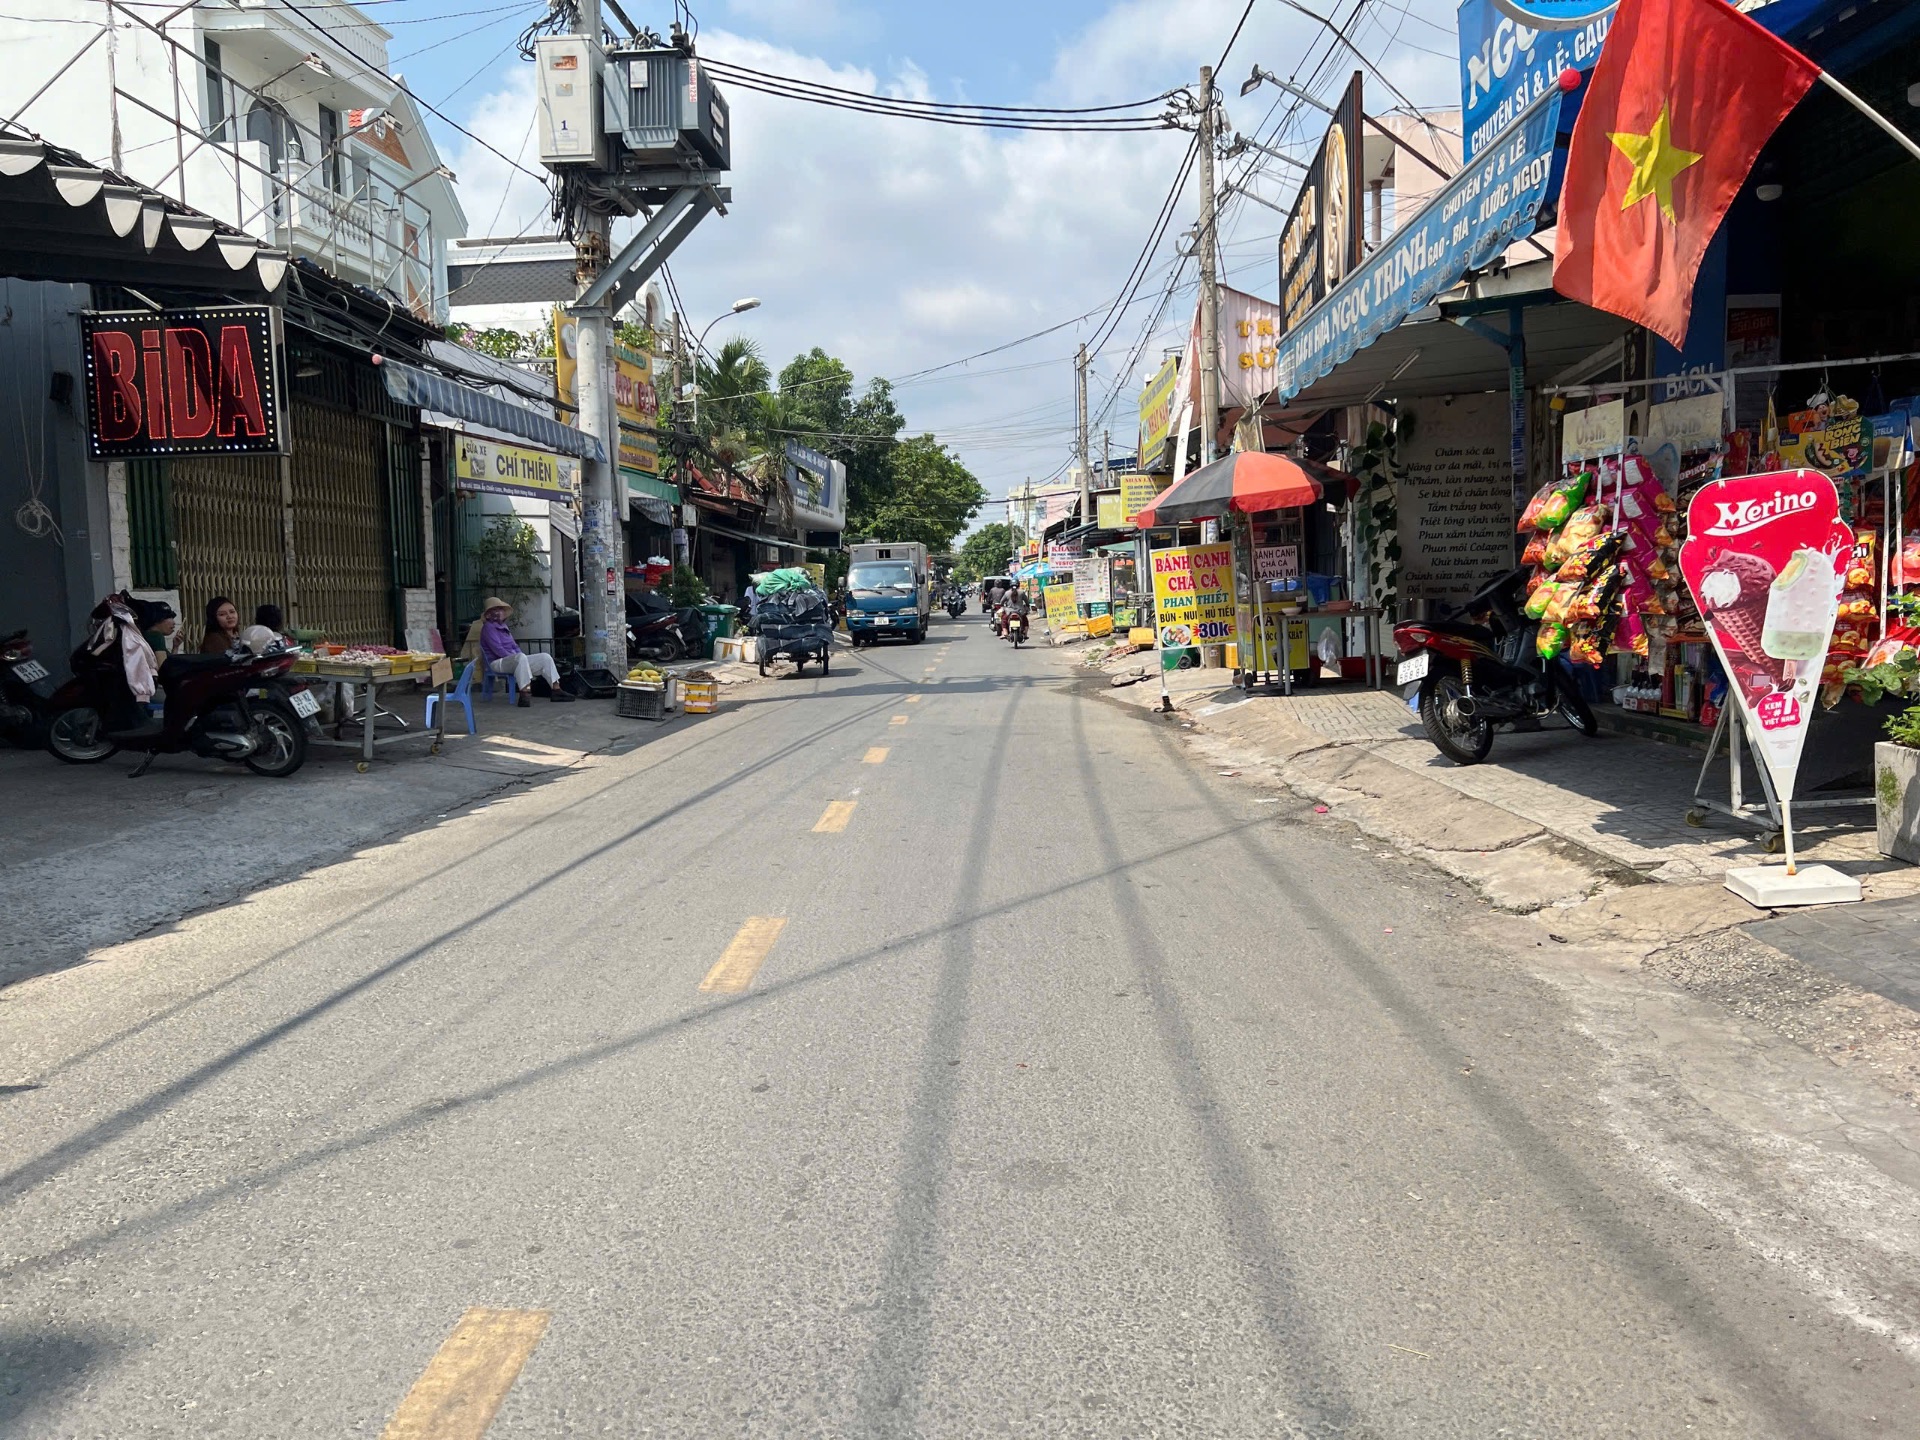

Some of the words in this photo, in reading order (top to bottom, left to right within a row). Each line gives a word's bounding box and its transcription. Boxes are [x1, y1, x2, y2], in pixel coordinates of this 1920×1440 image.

[1472, 96, 1513, 154] CHUYÊN
[1516, 72, 1530, 113] SỈ
[1533, 70, 1544, 98] &
[561, 120, 569, 130] 1
[1442, 174, 1482, 224] CHUYÊN
[1484, 154, 1496, 188] SỈ
[1497, 154, 1506, 176] &
[1428, 236, 1445, 267] GẠO
[1452, 216, 1469, 247] BIA
[1480, 182, 1510, 225] NƯỚC
[1512, 151, 1552, 200] NGỌT
[1295, 327, 1313, 367] BÁCH
[1331, 279, 1370, 334] NGỌC
[1374, 226, 1428, 307] TRINH
[466, 440, 478, 454] SỬA
[479, 445, 487, 456] XE
[1482, 446, 1495, 456] da
[496, 451, 518, 477] CHÍ
[521, 456, 552, 487] THIỆN
[1448, 461, 1461, 470] da
[1418, 489, 1430, 499] Se
[1480, 501, 1503, 512] body
[1714, 490, 1817, 530] Merino
[1419, 530, 1443, 540] Phun
[1275, 547, 1296, 558] CANH
[1422, 544, 1447, 553] Phun
[1470, 542, 1508, 554] Colagen
[1155, 553, 1190, 573] BÁNH
[1194, 551, 1231, 569] CANH
[1285, 566, 1296, 576] MÌ
[1168, 570, 1197, 592] CHẢ
[1200, 569, 1221, 588] CÁ
[1163, 596, 1193, 608] PHAN
[1195, 588, 1229, 605] THIẾT
[1160, 611, 1176, 623] BÚN
[1184, 611, 1197, 620] NUI
[1205, 606, 1216, 618] HỦ
[1217, 605, 1235, 618] TIẾU
[1198, 621, 1229, 638] 30k
[1765, 701, 1782, 710] KEM
[1780, 714, 1796, 723] NAM
